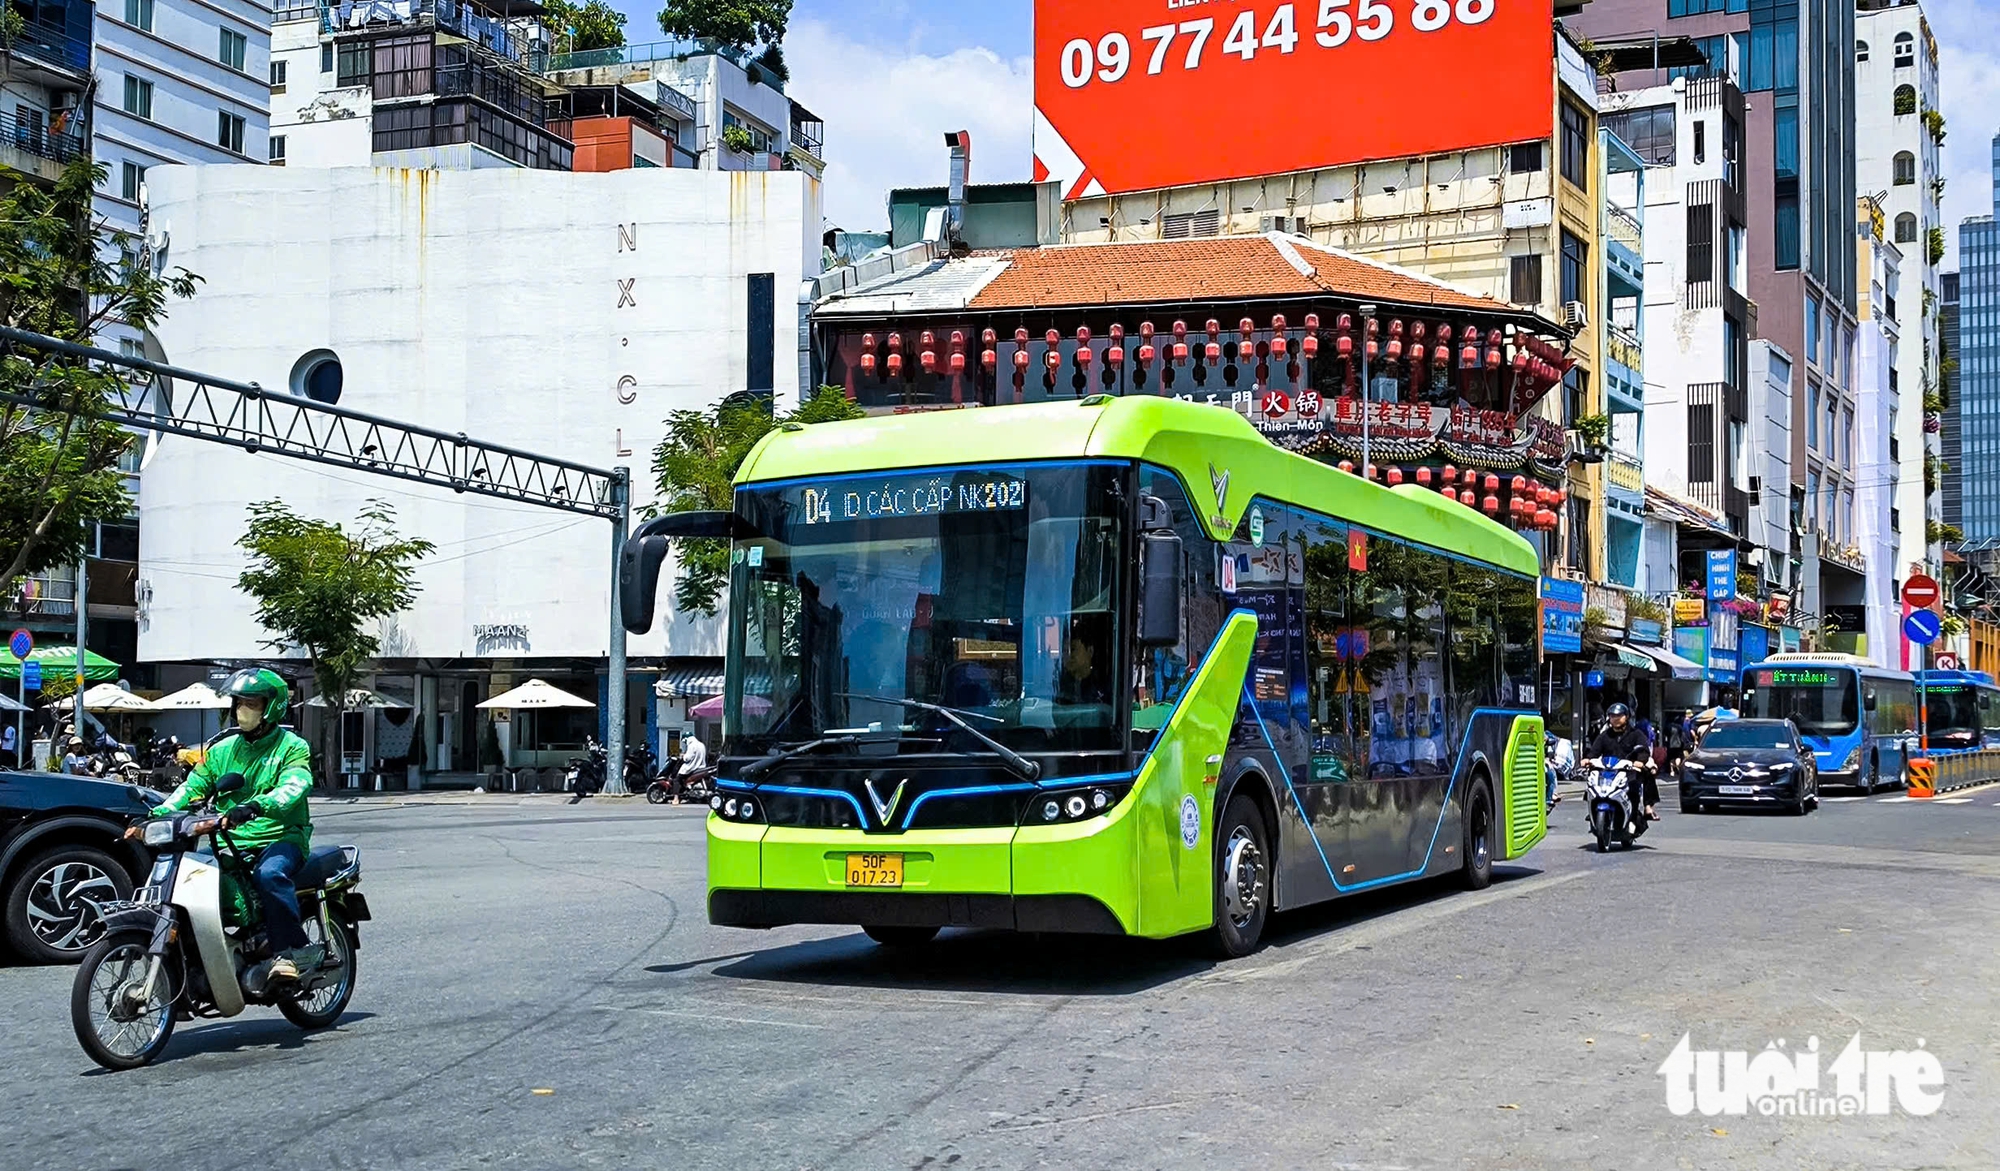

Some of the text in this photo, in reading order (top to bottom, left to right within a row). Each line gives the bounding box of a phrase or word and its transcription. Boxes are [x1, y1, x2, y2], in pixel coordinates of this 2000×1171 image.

[1060, 32, 1131, 89] 09
[1141, 17, 1214, 75] 77
[1222, 3, 1299, 61] 44
[1314, 0, 1395, 48] 55
[805, 488, 831, 524] D4
[866, 483, 906, 515] CÁC
[1941, 659, 1952, 670] K
[863, 855, 886, 868] 50F
[852, 870, 896, 884] 017.23
